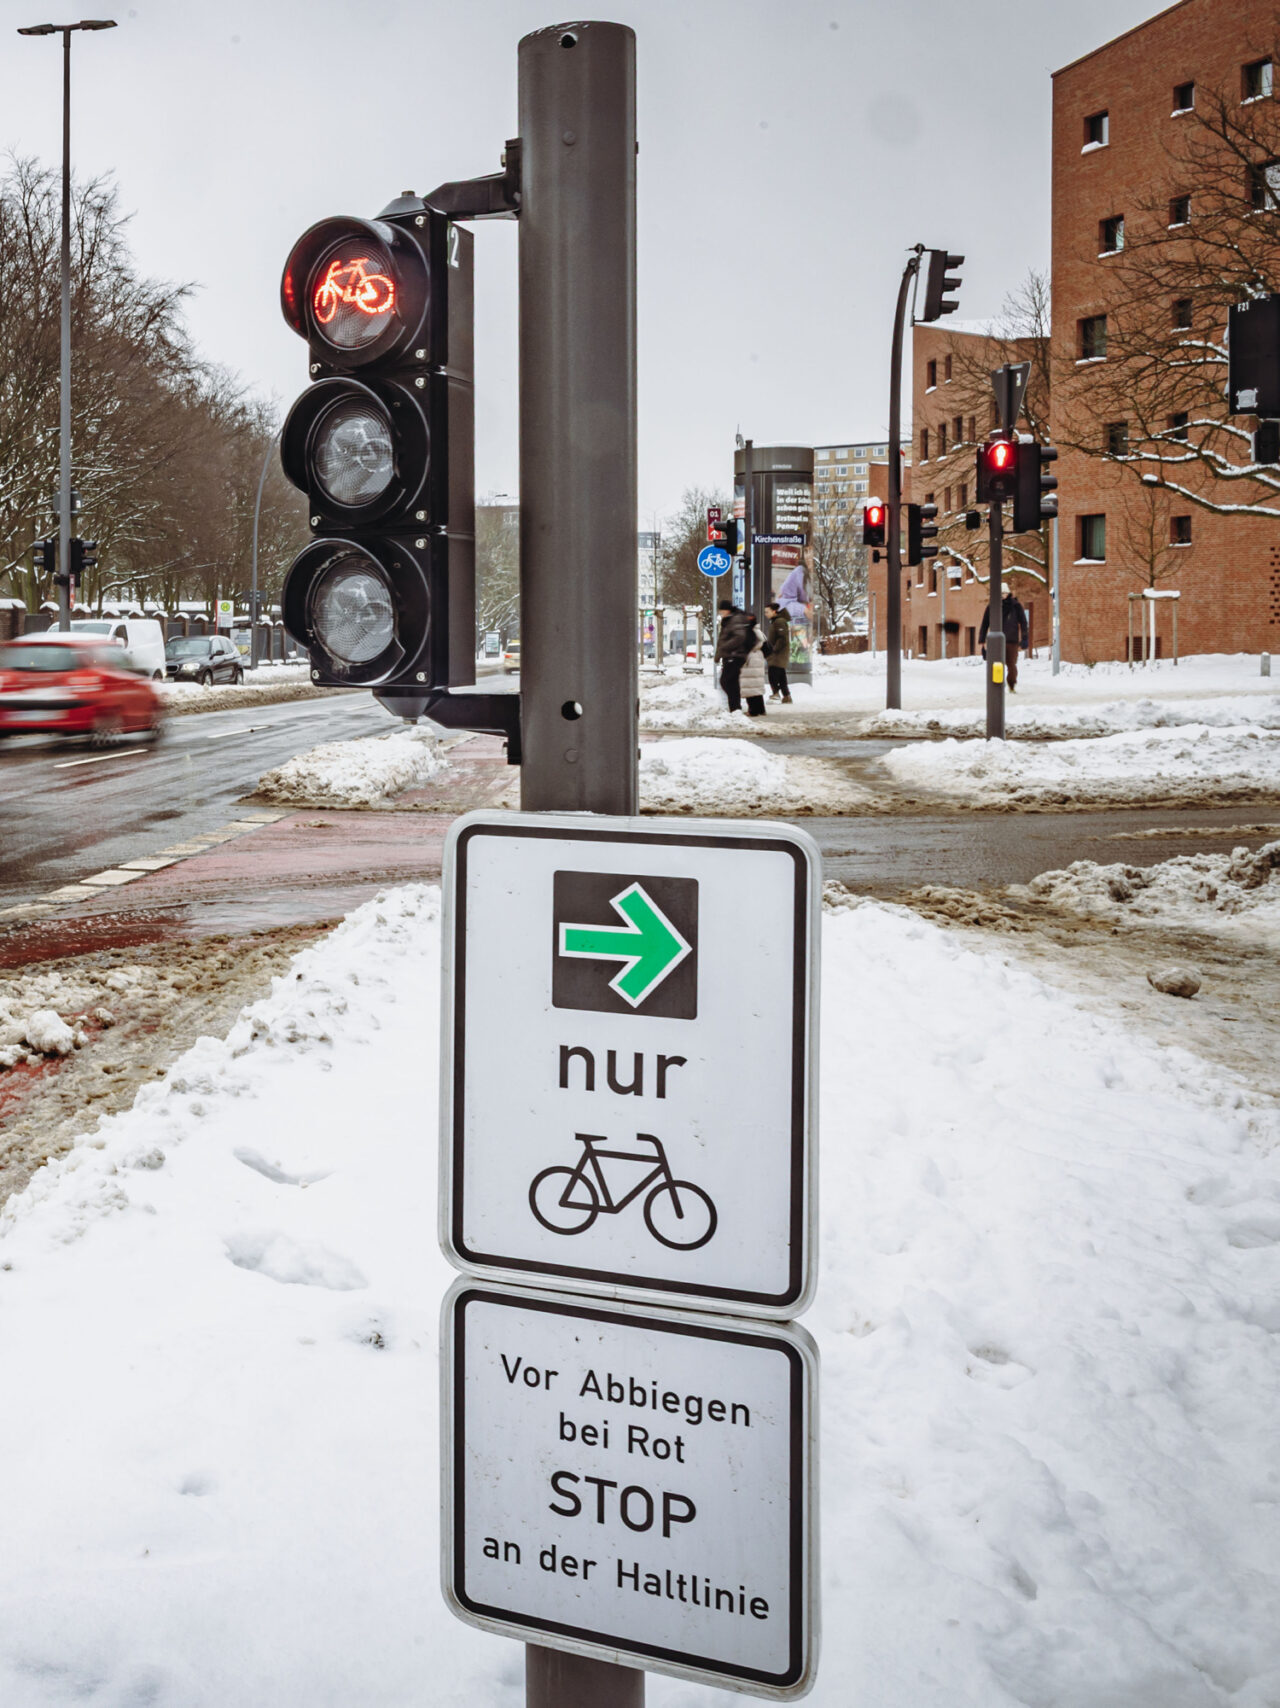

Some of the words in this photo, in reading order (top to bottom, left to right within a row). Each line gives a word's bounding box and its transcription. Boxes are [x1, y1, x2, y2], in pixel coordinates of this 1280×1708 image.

[1237, 301, 1249, 312] F21
[709, 510, 719, 518] 01
[754, 535, 802, 544] Kirchenstraße
[558, 1043, 688, 1099] nur
[500, 1353, 559, 1390] Vor
[579, 1369, 752, 1426] Abbiegen
[559, 1412, 609, 1448] bei
[627, 1424, 686, 1463] Rot
[547, 1469, 698, 1539] STOP
[482, 1536, 521, 1565] an
[539, 1544, 597, 1580] der
[617, 1558, 770, 1620] Haltlinie
